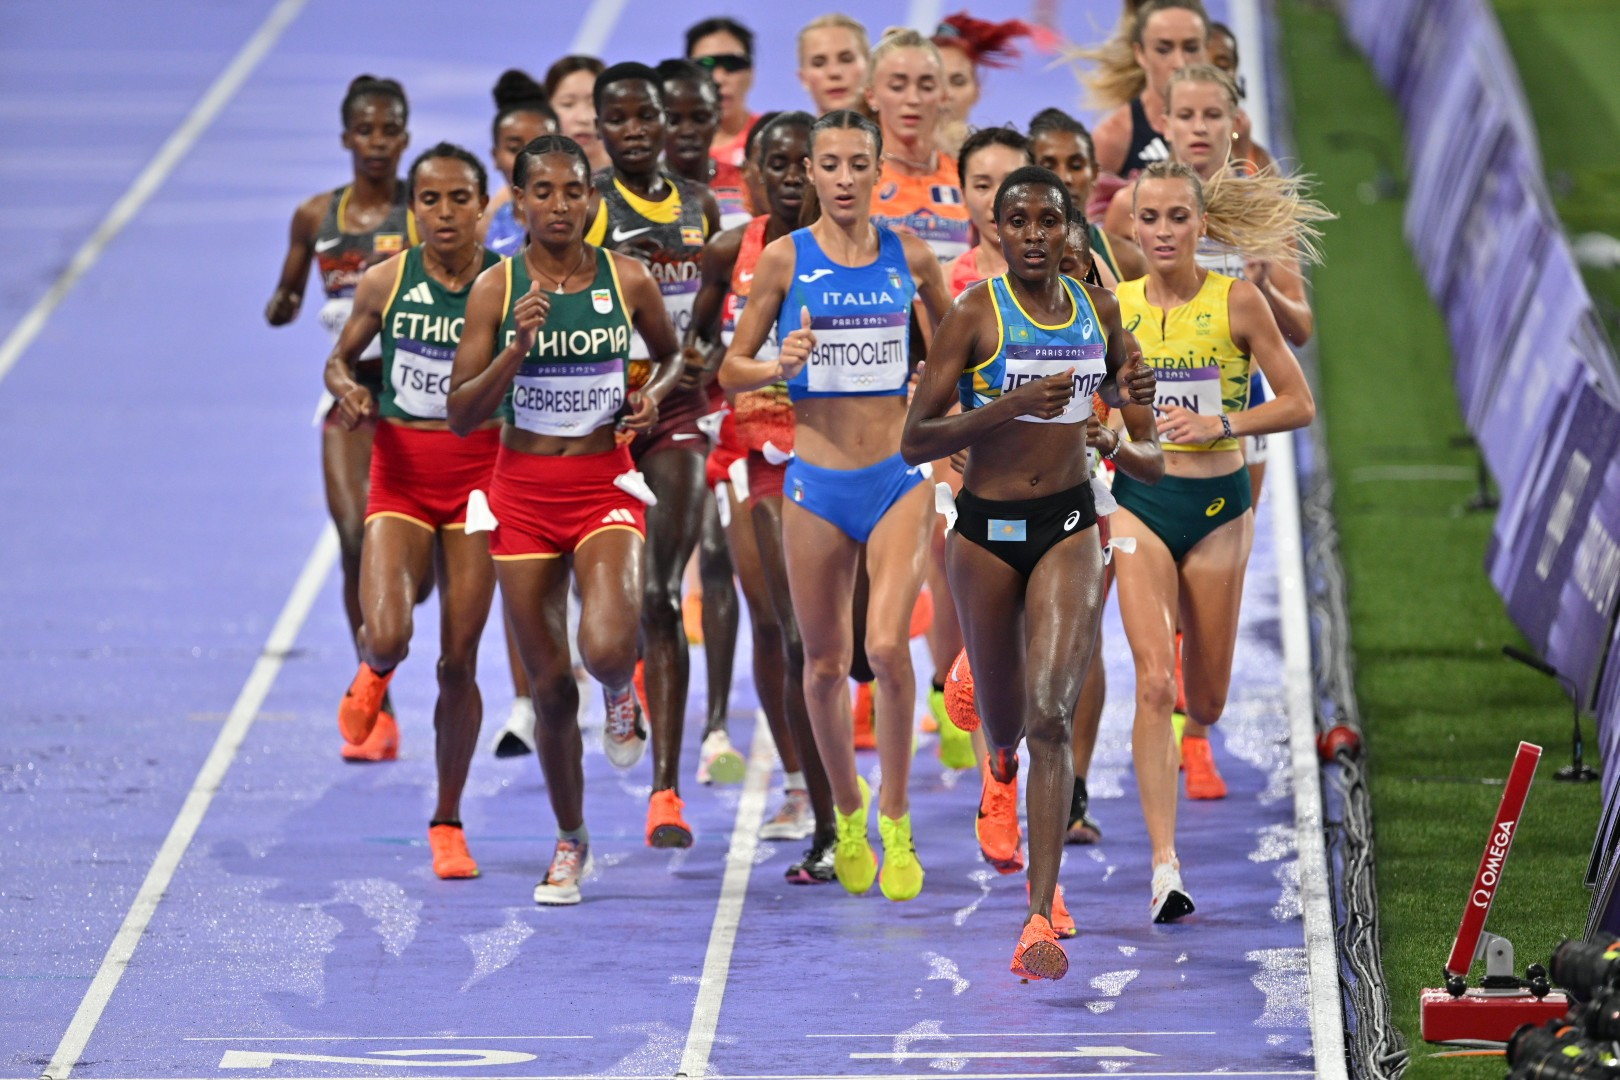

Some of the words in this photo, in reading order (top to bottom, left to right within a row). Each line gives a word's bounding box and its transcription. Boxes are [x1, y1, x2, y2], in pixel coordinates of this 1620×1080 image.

[823, 291, 894, 306] ITALIA
[392, 311, 466, 343] ETHIO
[832, 318, 861, 326] PARIS
[863, 316, 888, 325] 2024
[505, 325, 628, 357] EHIOPIA
[811, 339, 904, 367] BATTOCLETTI
[1035, 349, 1063, 357] PARIS
[1065, 348, 1085, 357] 2024
[538, 366, 567, 375] PARIS
[569, 365, 596, 374] 2024
[1165, 370, 1191, 379] 2024
[514, 385, 621, 413] GEBRESELAMA
[1481, 820, 1515, 886] OMEGA
